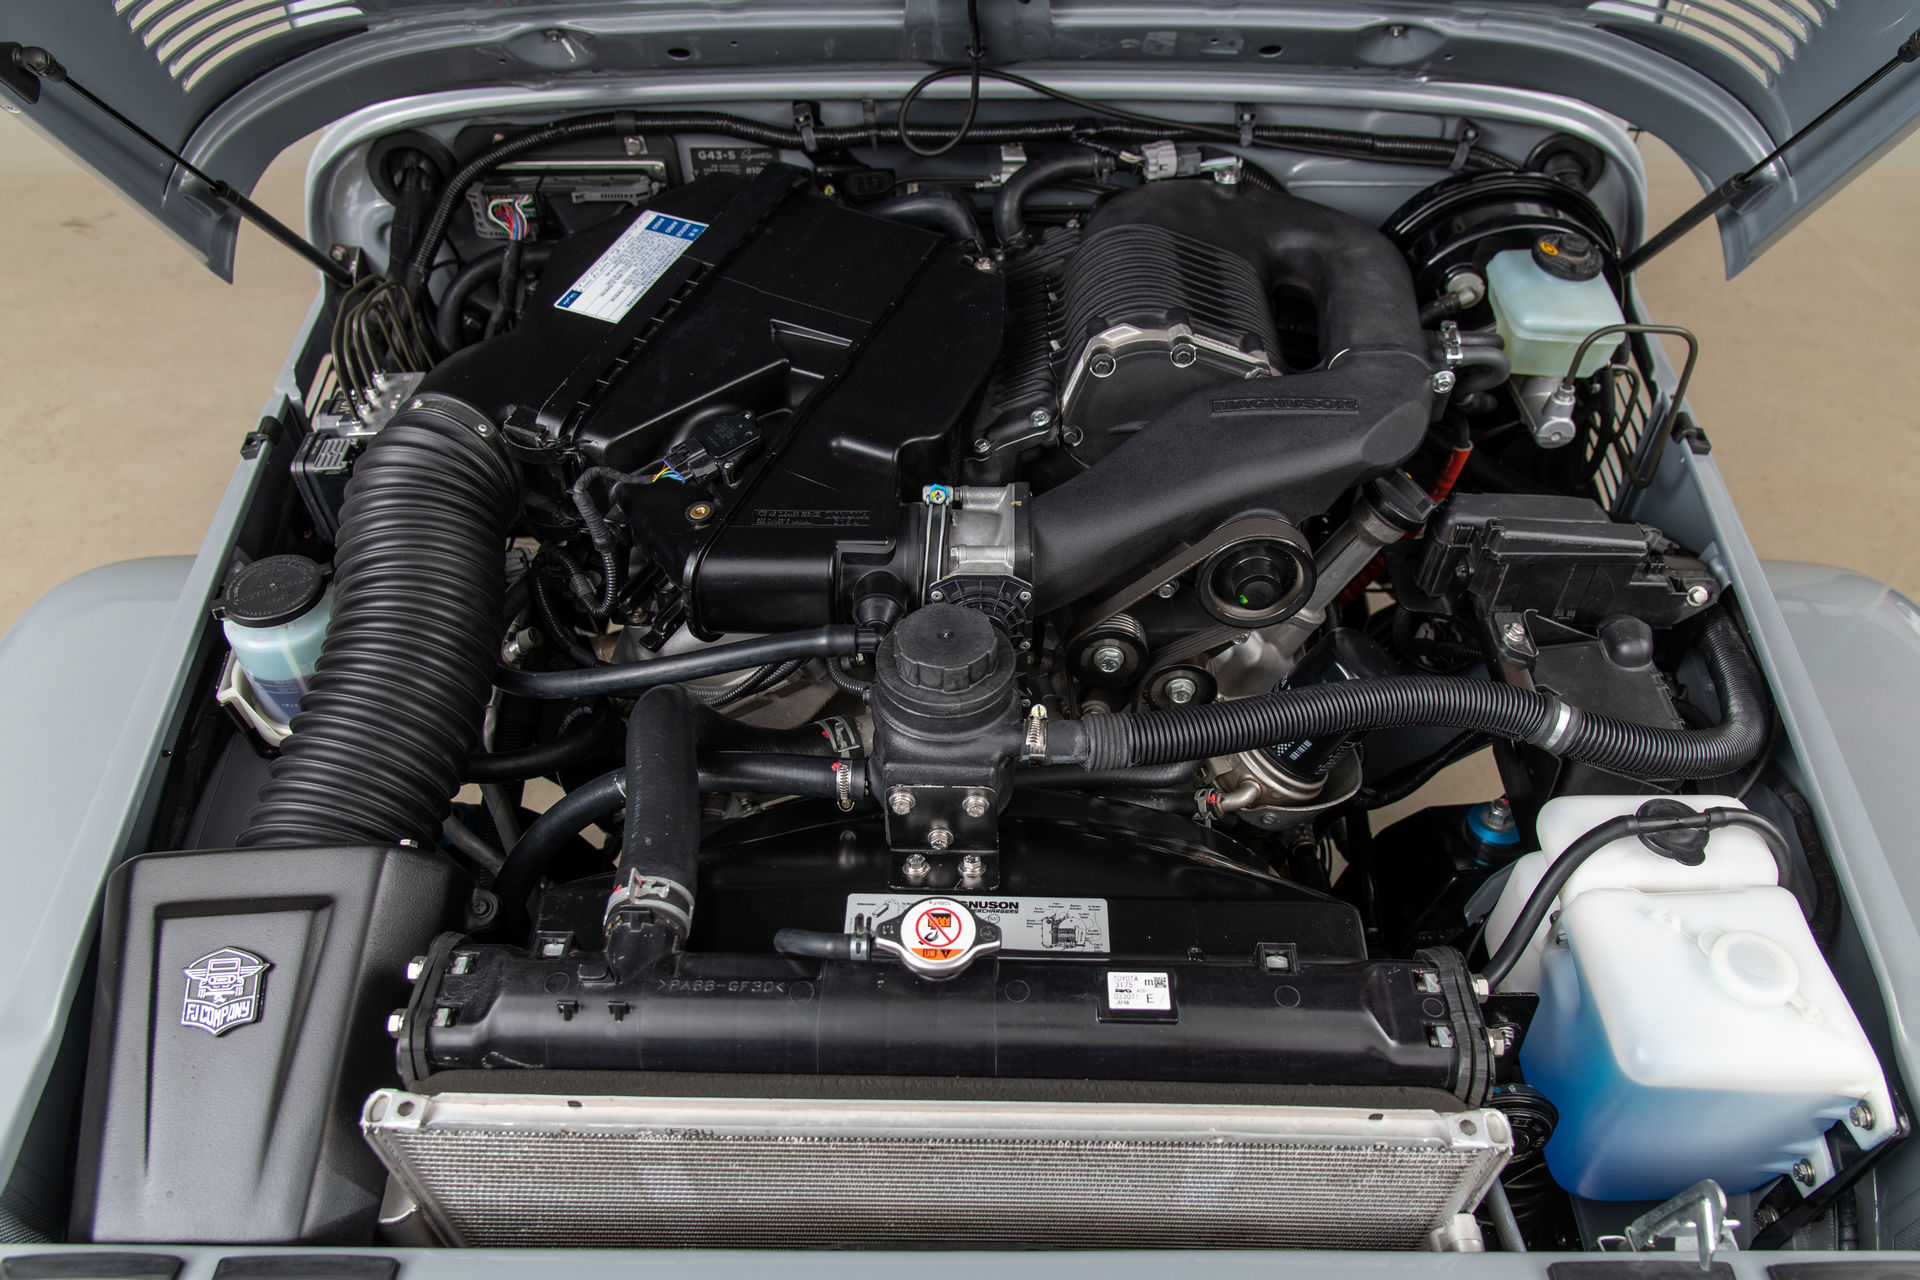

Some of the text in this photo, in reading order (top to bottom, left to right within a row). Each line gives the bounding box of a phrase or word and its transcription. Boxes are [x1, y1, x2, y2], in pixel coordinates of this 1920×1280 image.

[1214, 398, 1354, 411] MAGNUSON
[1147, 994, 1154, 1003] E
[186, 1000, 250, 1028] FJ COMPANY
